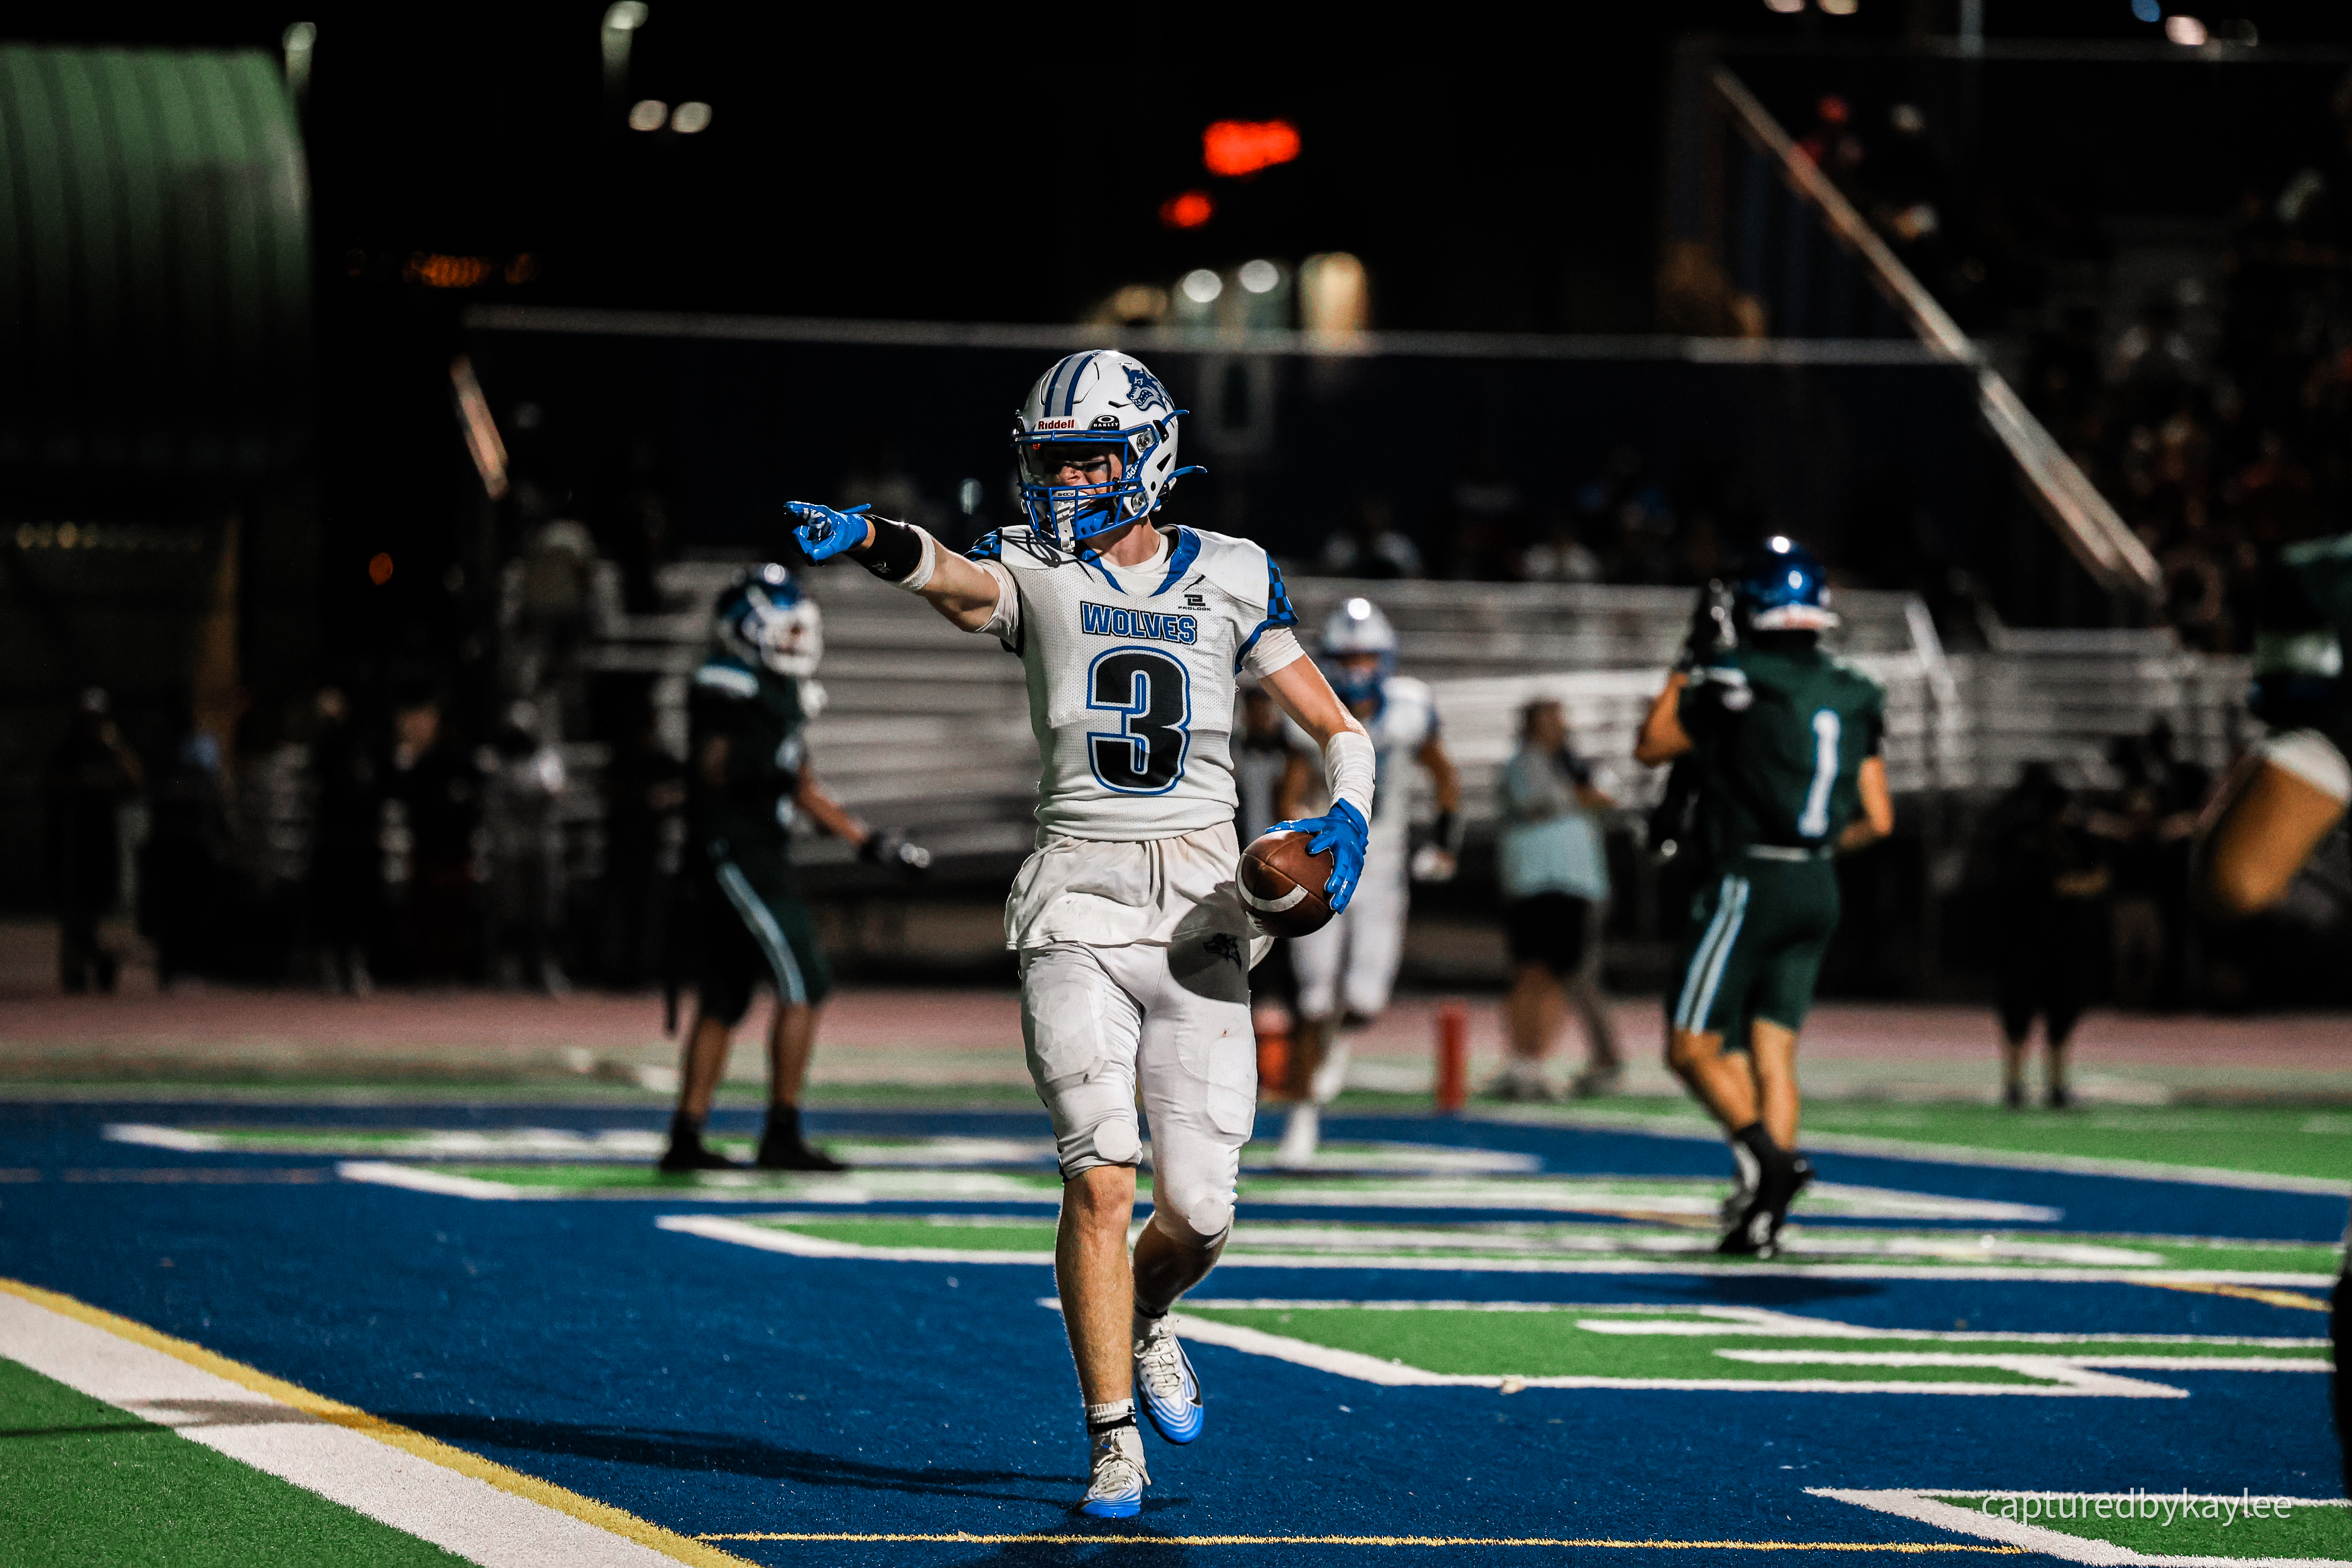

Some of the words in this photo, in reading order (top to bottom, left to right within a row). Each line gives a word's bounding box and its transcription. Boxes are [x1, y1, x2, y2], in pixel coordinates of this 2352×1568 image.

[1038, 419, 1074, 430] Riddell
[1080, 600, 1197, 645] WOLVES
[1086, 645, 1191, 795] 3
[1798, 709, 1840, 838] 1
